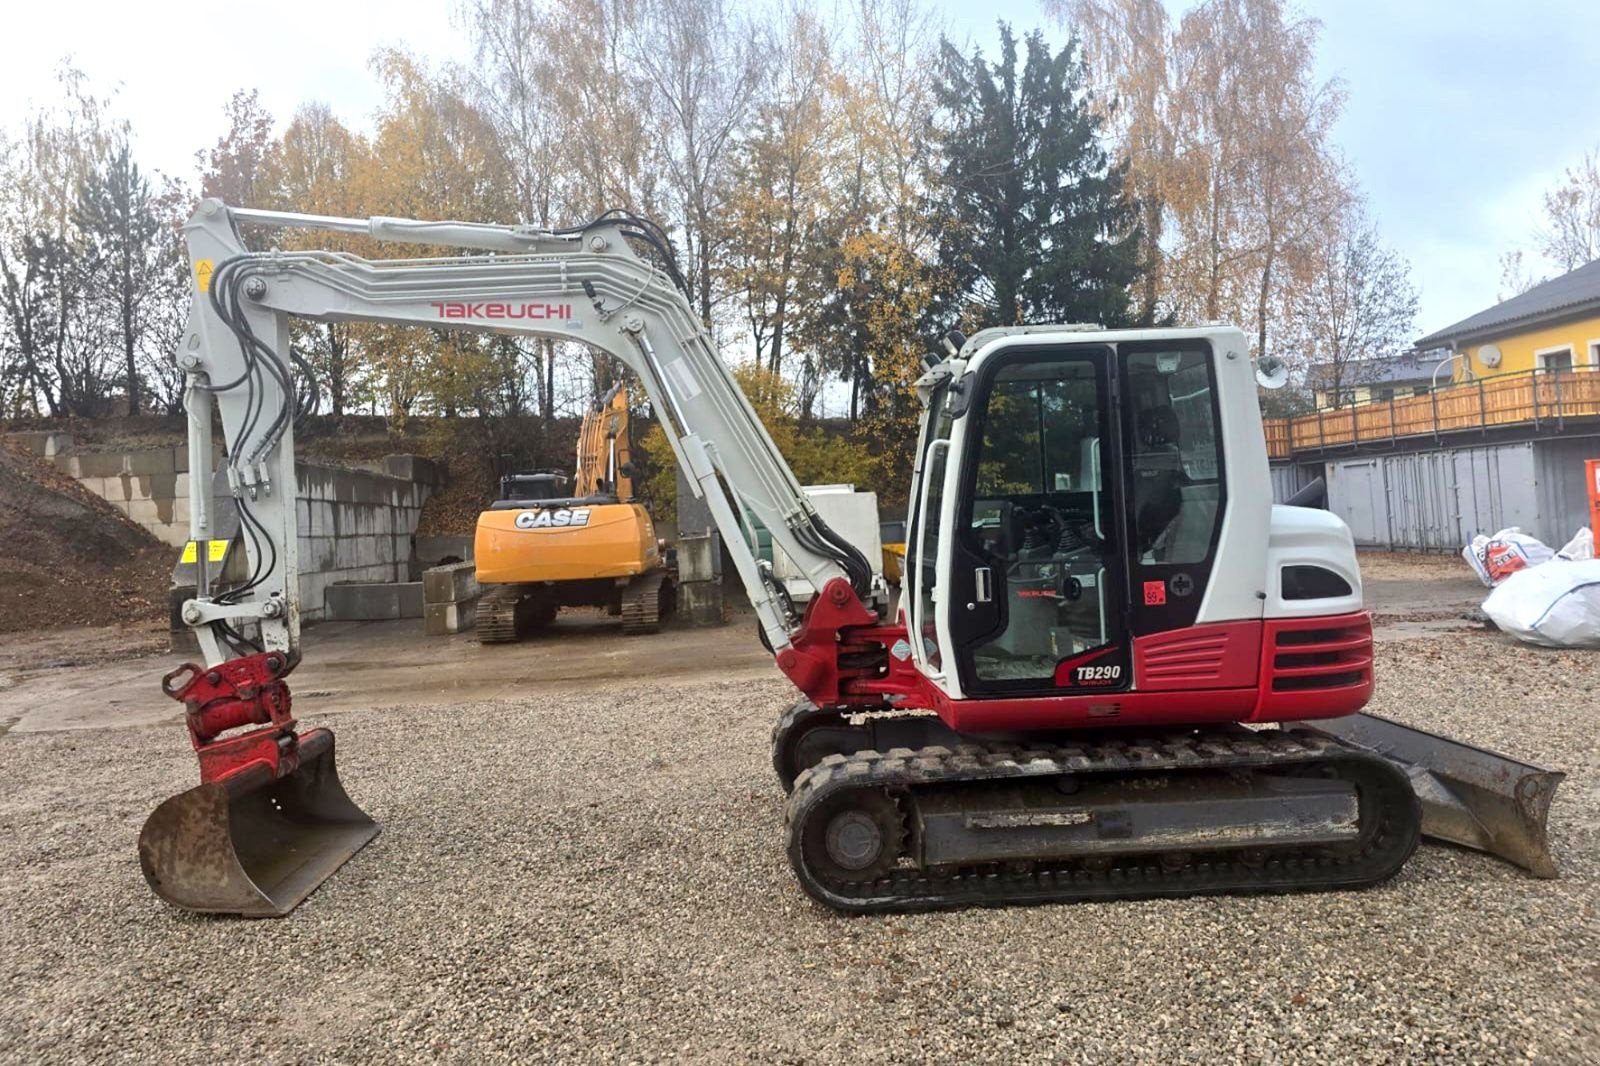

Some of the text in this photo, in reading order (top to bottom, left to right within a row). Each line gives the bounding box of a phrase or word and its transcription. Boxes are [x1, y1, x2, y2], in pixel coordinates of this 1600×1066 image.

[431, 302, 571, 319] TAKEUCHI
[515, 508, 591, 528] CASE
[1077, 665, 1121, 680] TB290
